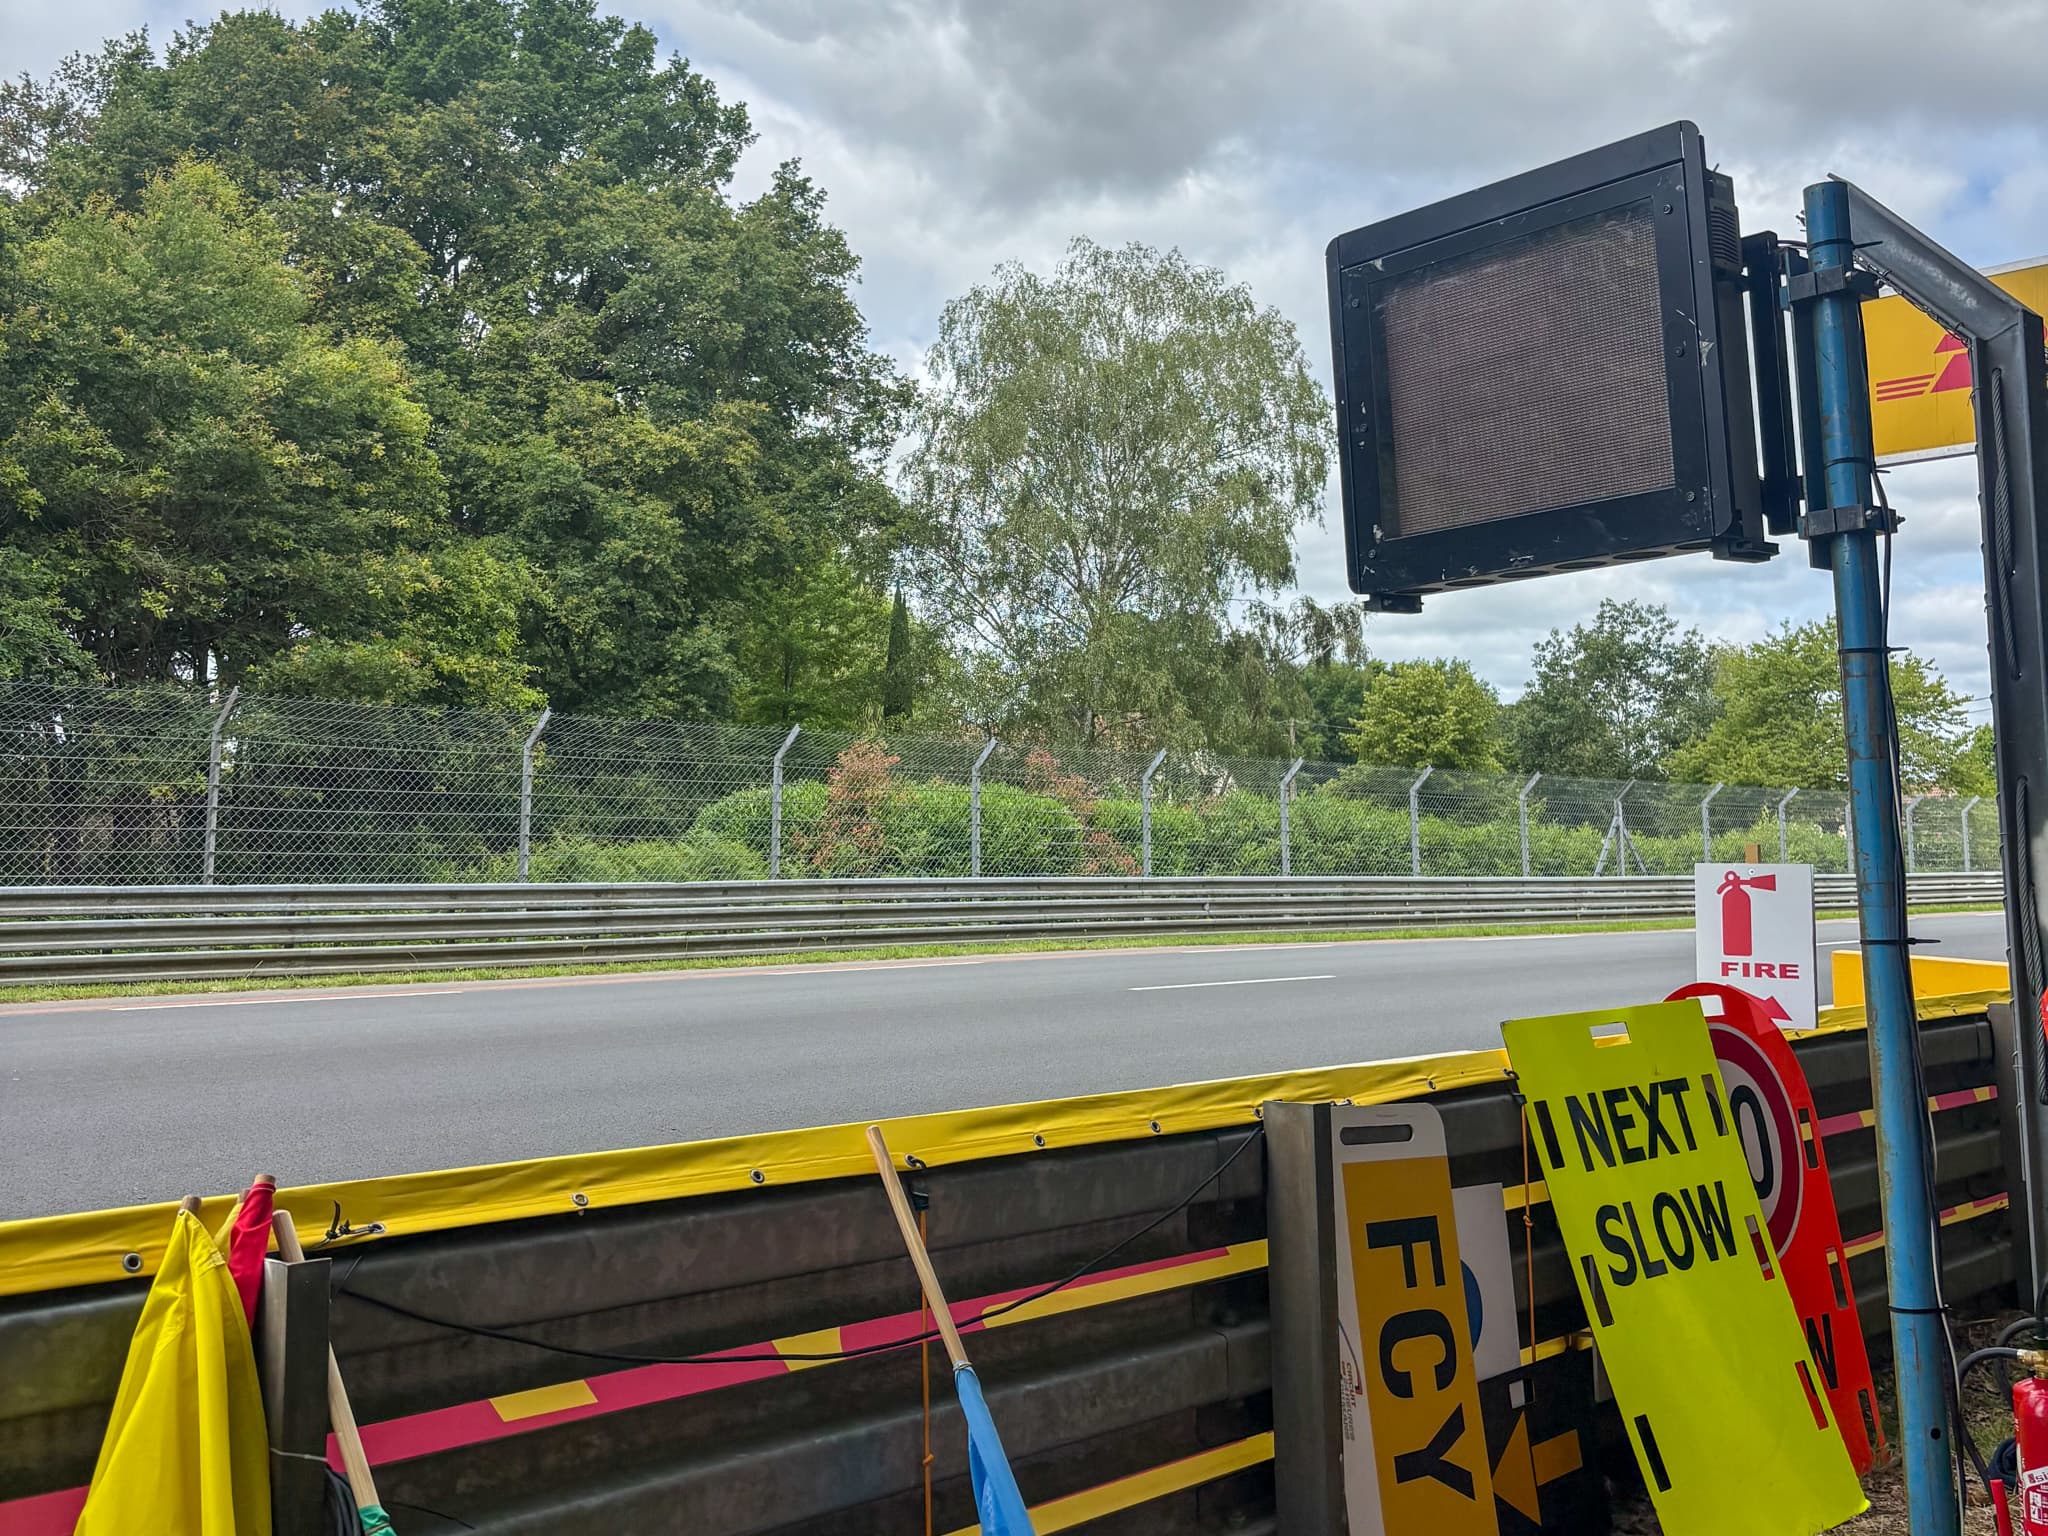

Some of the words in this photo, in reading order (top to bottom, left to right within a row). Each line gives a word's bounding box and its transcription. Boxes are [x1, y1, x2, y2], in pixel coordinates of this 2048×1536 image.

[1720, 961, 1800, 980] FIRE
[1565, 1077, 1698, 1172] NEXT
[1595, 1180, 1738, 1288] SLOW
[1365, 1215, 1477, 1502] FCY
